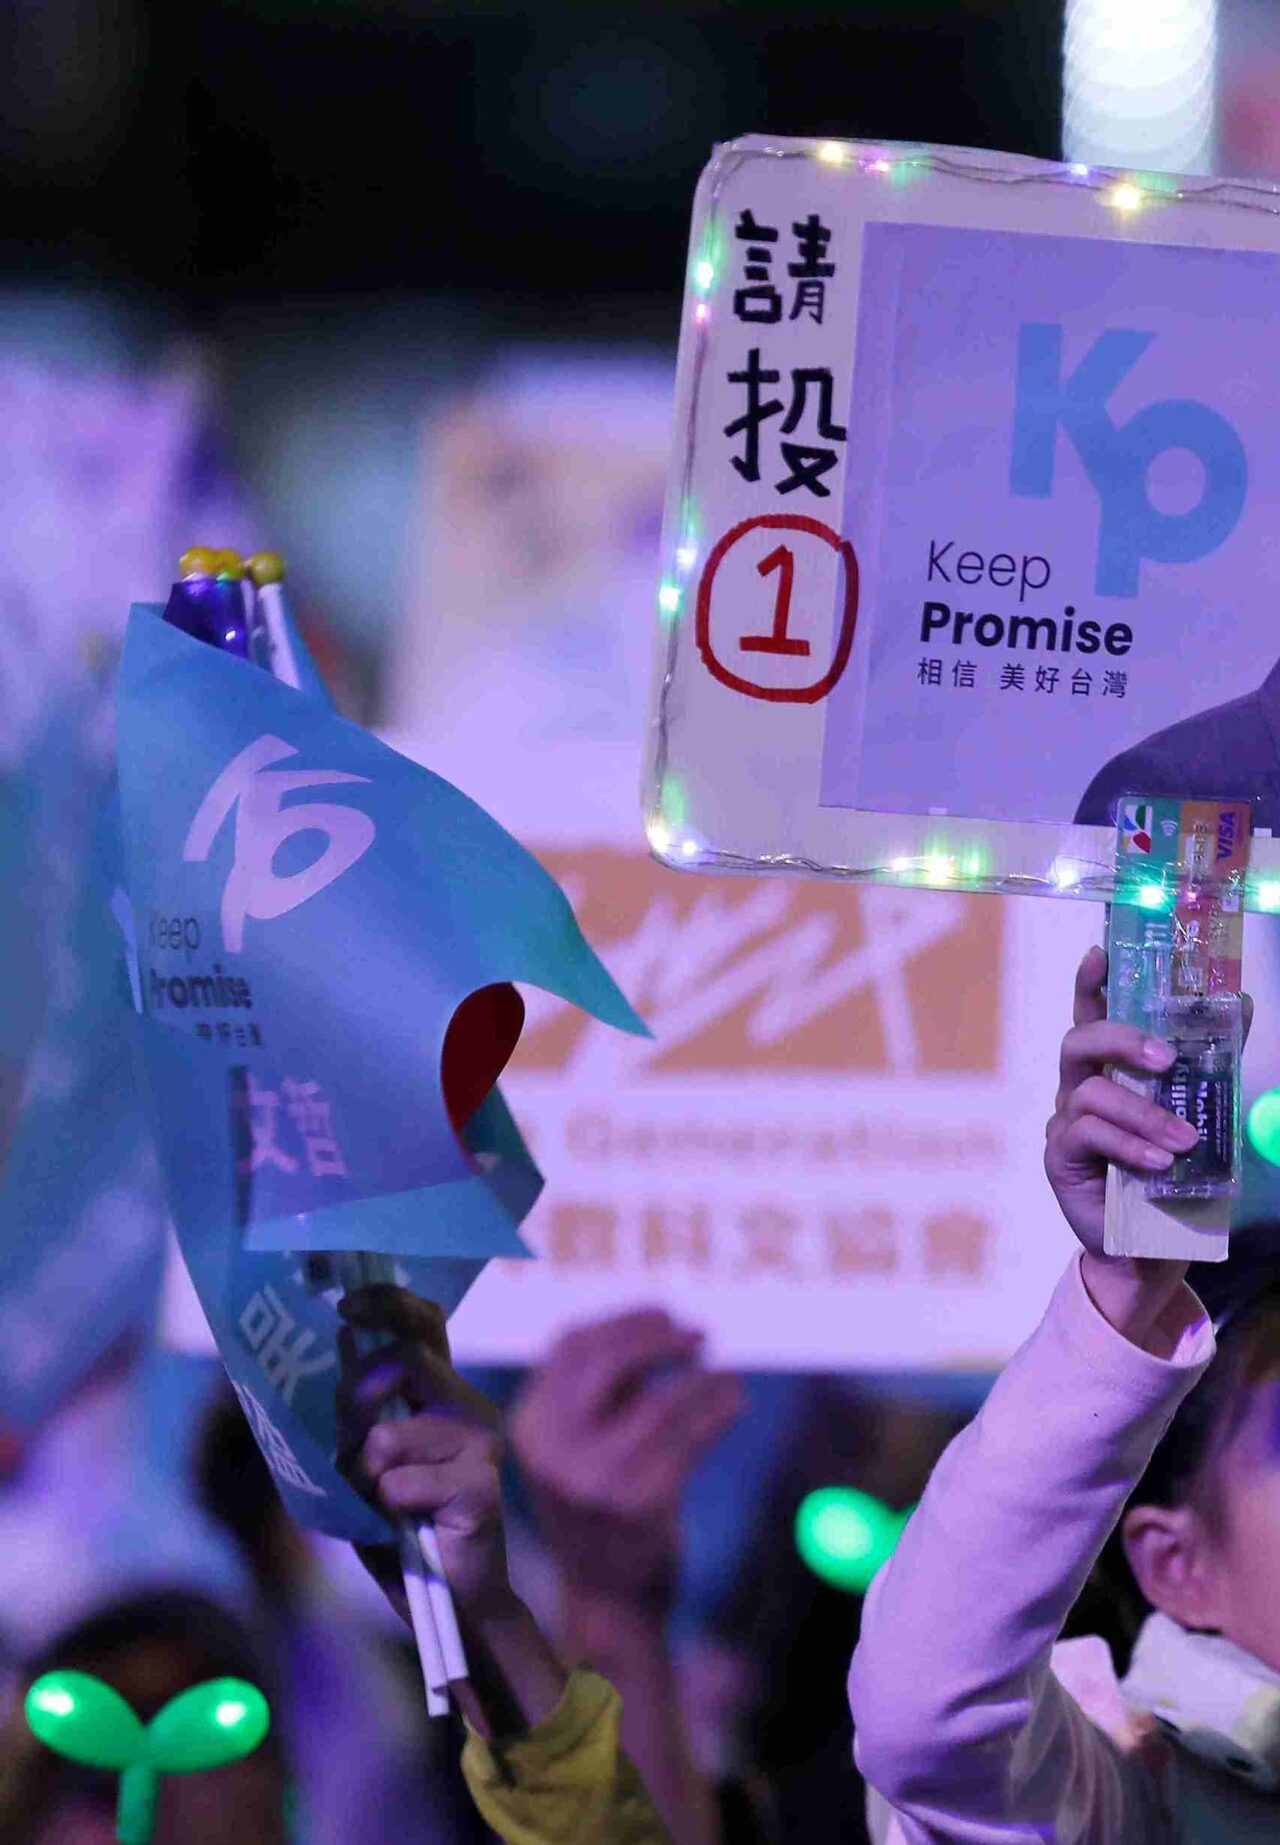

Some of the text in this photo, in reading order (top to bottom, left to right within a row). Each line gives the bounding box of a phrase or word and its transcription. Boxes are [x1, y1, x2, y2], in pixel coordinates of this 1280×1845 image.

[724, 208, 847, 498] 請投
[927, 540, 1051, 602] Keep
[919, 601, 1133, 656] Promise
[917, 657, 1128, 700] 相信 美好台灣
[1216, 811, 1237, 861] VISA
[149, 917, 200, 962] eep
